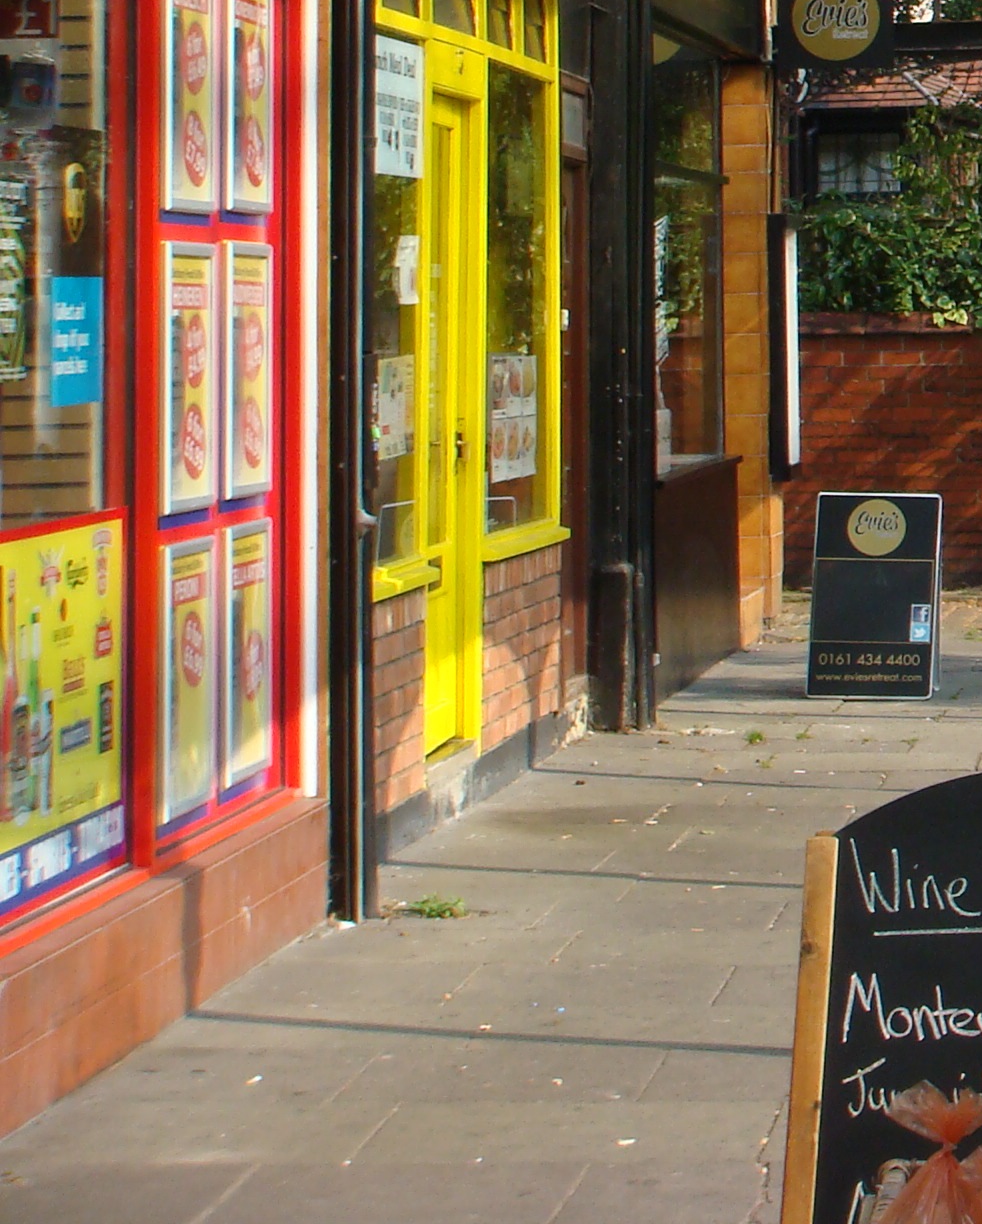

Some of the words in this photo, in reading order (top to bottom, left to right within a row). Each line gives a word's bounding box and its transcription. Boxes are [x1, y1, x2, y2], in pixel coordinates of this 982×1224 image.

[855, 511, 899, 535] Evie's
[818, 653, 851, 666] 0161
[856, 653, 882, 666] 434
[886, 653, 921, 666] 4400
[816, 673, 923, 682] www.eviesretreat.com
[850, 837, 982, 917] Wine
